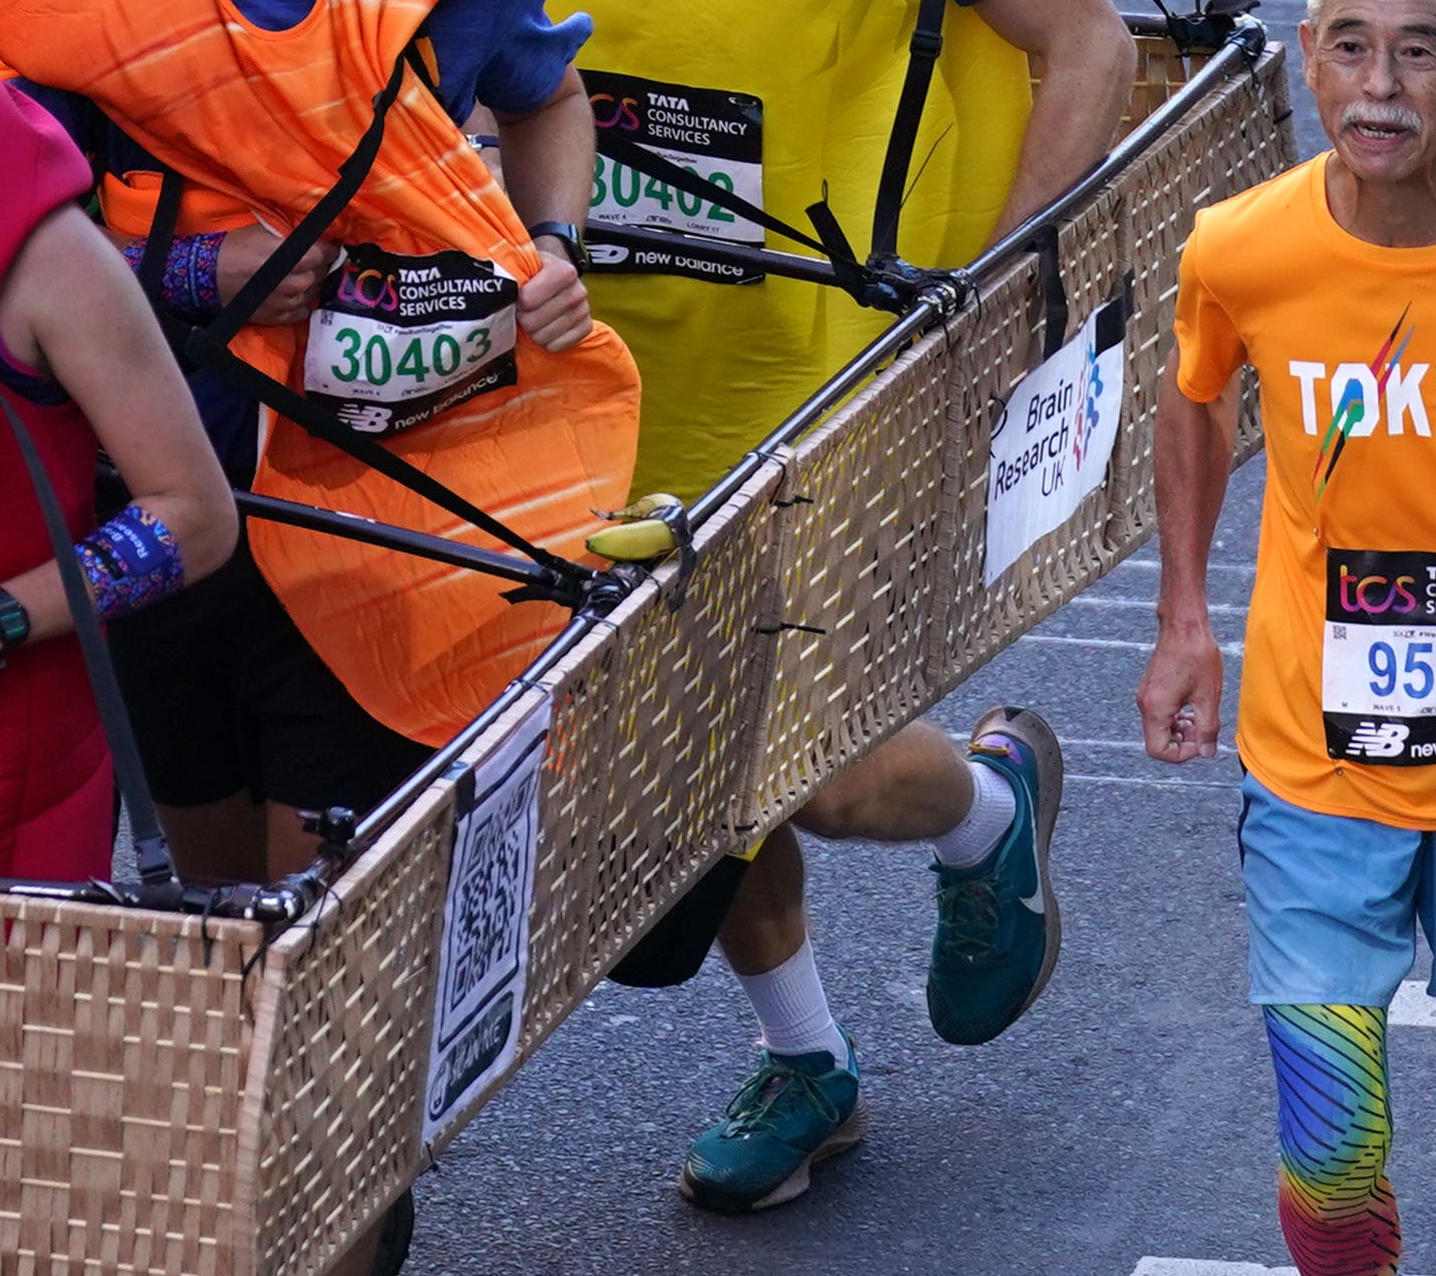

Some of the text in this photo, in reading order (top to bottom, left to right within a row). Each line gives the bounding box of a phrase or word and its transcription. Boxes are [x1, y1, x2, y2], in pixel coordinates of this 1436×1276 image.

[647, 92, 690, 112] TATA
[647, 108, 748, 136] CONSULTANCY
[648, 124, 711, 146] SERVICES
[635, 250, 672, 266] new
[398, 267, 442, 284] TATA
[398, 278, 504, 301] CONSULTANCY
[399, 295, 467, 317] SERVICES
[330, 327, 493, 387] 30403
[431, 373, 499, 416] balance
[1026, 377, 1074, 433] Brain
[994, 416, 1070, 501] Research
[1041, 455, 1067, 498] UK
[1339, 564, 1417, 614] tcs
